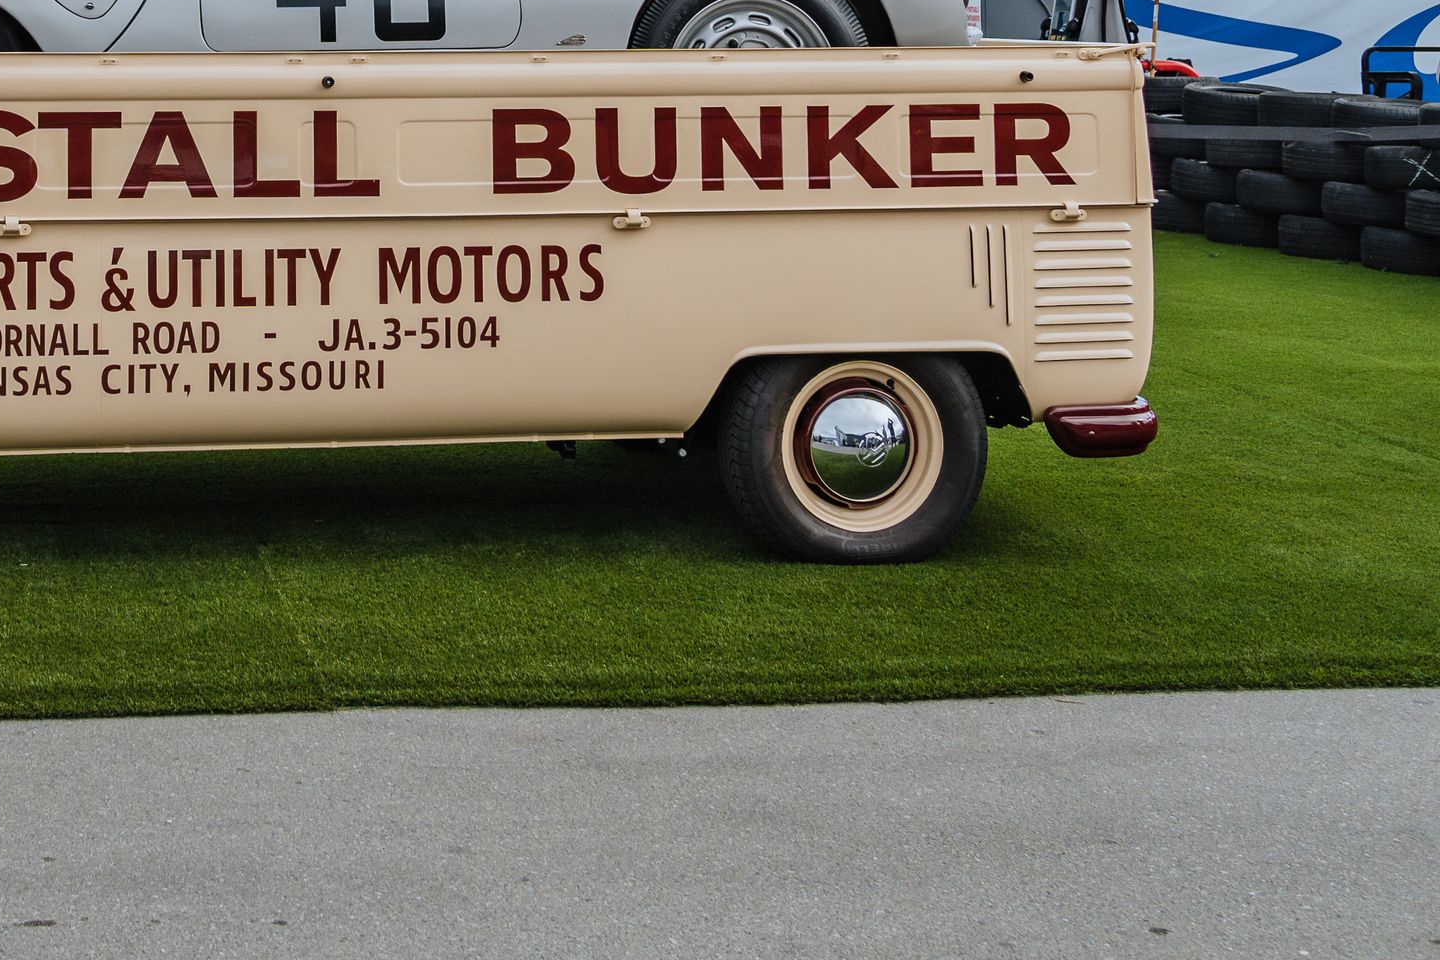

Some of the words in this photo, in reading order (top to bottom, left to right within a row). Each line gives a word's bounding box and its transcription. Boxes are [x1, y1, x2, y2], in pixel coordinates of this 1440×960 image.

[492, 103, 1077, 194] BUNKER
[148, 248, 341, 308] UTILITY
[378, 244, 604, 304] MOTORS
[132, 321, 220, 354] ROAD
[101, 364, 191, 397] CITY,
[208, 359, 385, 392] MISSOURI
